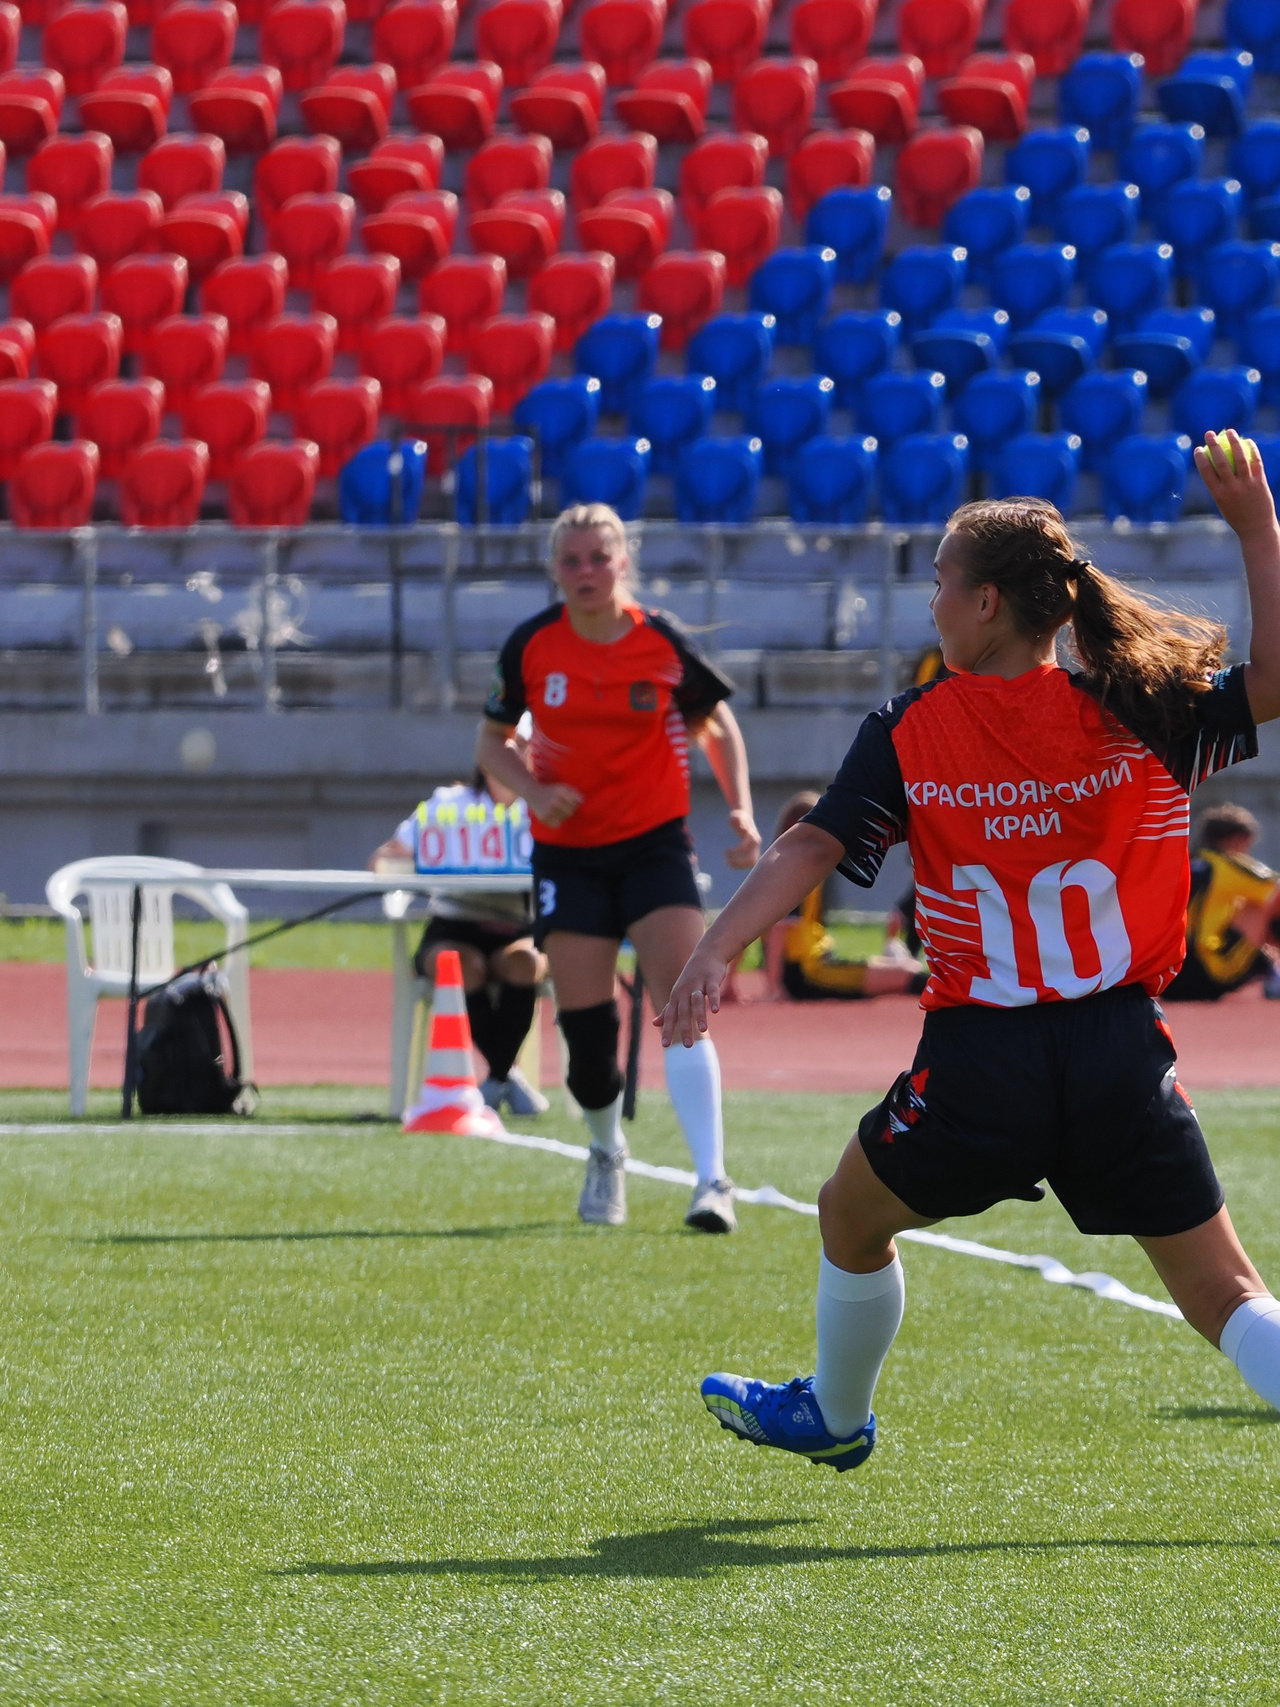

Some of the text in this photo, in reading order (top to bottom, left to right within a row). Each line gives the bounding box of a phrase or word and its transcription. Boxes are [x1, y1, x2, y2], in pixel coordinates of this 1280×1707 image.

[545, 672, 568, 707] 8
[904, 756, 1133, 808] КРАСНОЯРСКИЙ
[984, 807, 1062, 840] КРАЙ
[952, 859, 1132, 1008] 10
